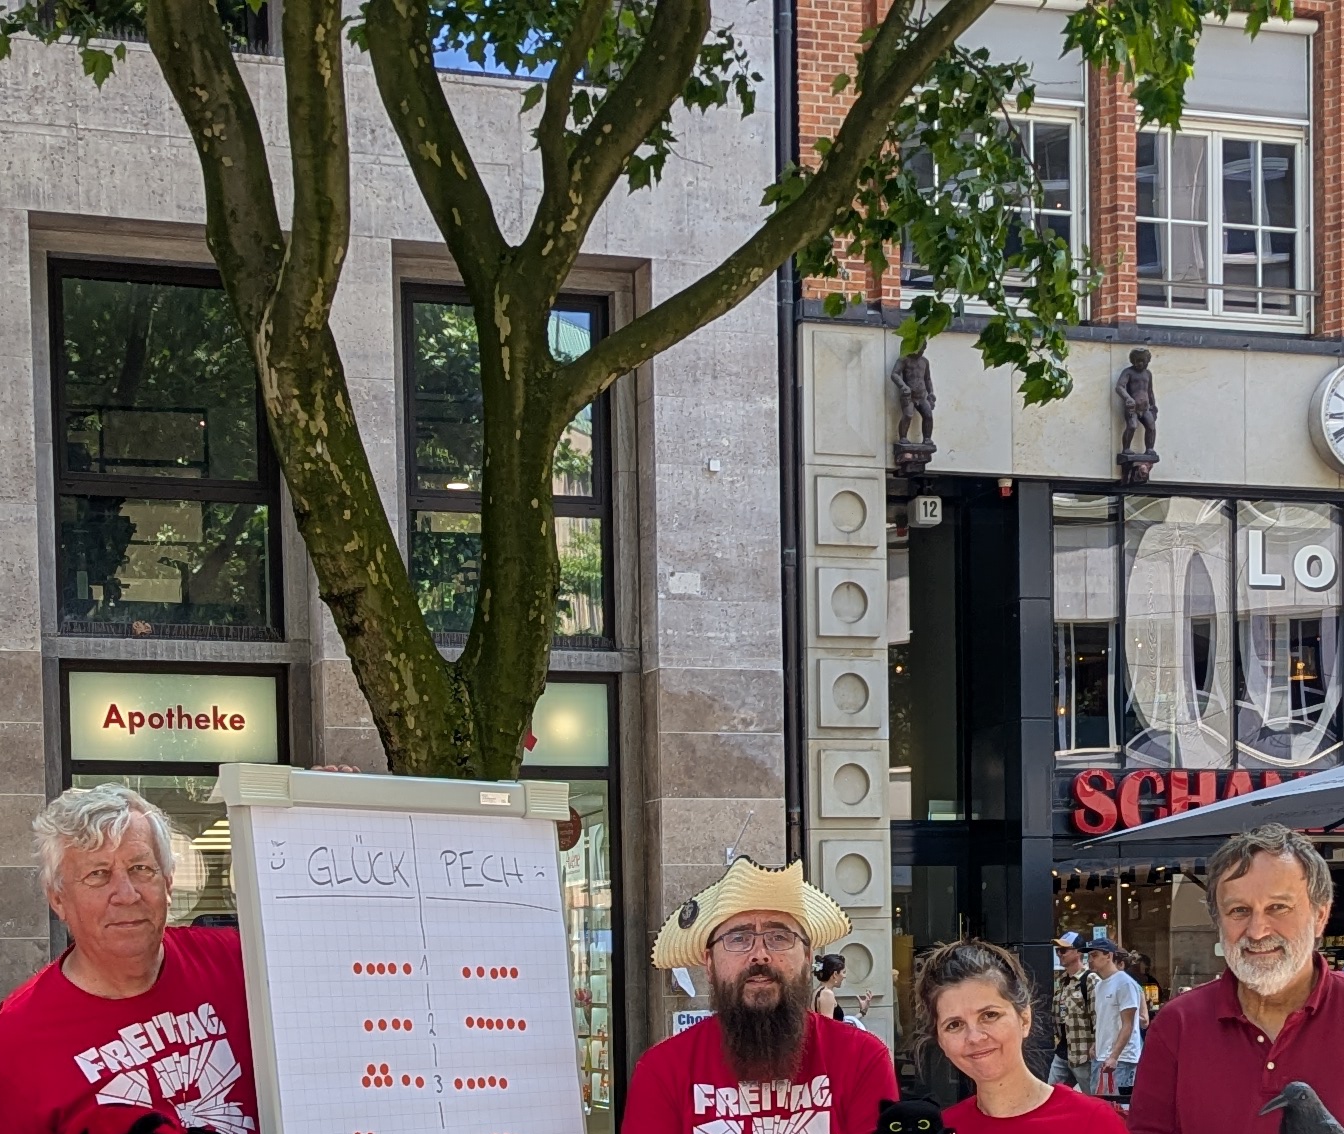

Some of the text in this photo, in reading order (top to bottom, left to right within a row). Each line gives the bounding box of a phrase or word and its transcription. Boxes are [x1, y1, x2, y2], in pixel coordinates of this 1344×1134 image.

[922, 500, 938, 518] 12
[102, 703, 247, 735] Apotheke
[308, 835, 524, 888] GLÜCK PECH
[419, 954, 429, 976] 1
[427, 1012, 437, 1037] 2
[74, 1003, 226, 1083] FREITAG
[433, 1074, 444, 1094] 3
[693, 1074, 832, 1117] FREITAG
